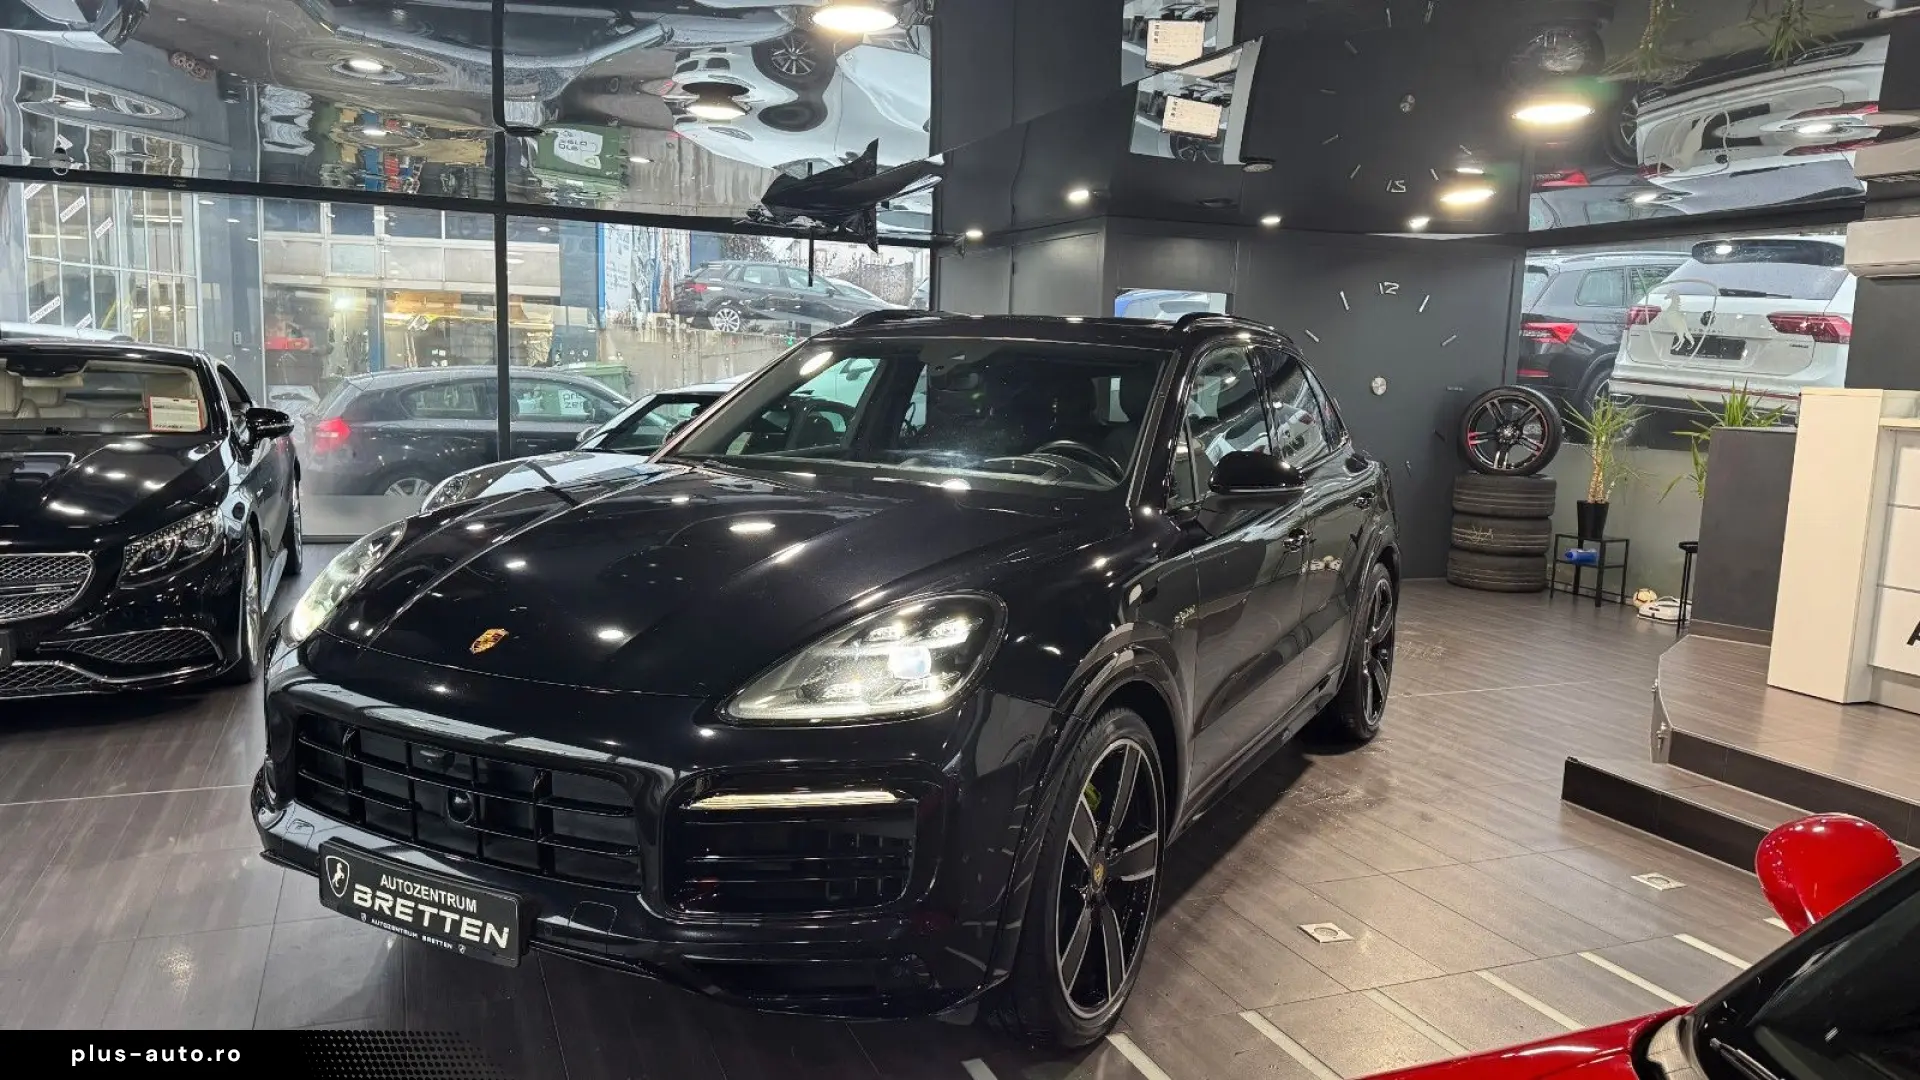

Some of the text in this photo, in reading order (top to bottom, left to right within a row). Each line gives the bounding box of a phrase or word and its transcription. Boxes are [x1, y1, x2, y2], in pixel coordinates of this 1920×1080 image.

[1379, 282, 1399, 295] 12
[380, 874, 477, 913] AUTOZENTRUM
[353, 883, 510, 949] BRETTEN
[371, 918, 453, 950] AUTOZENTRUM BRETTEN
